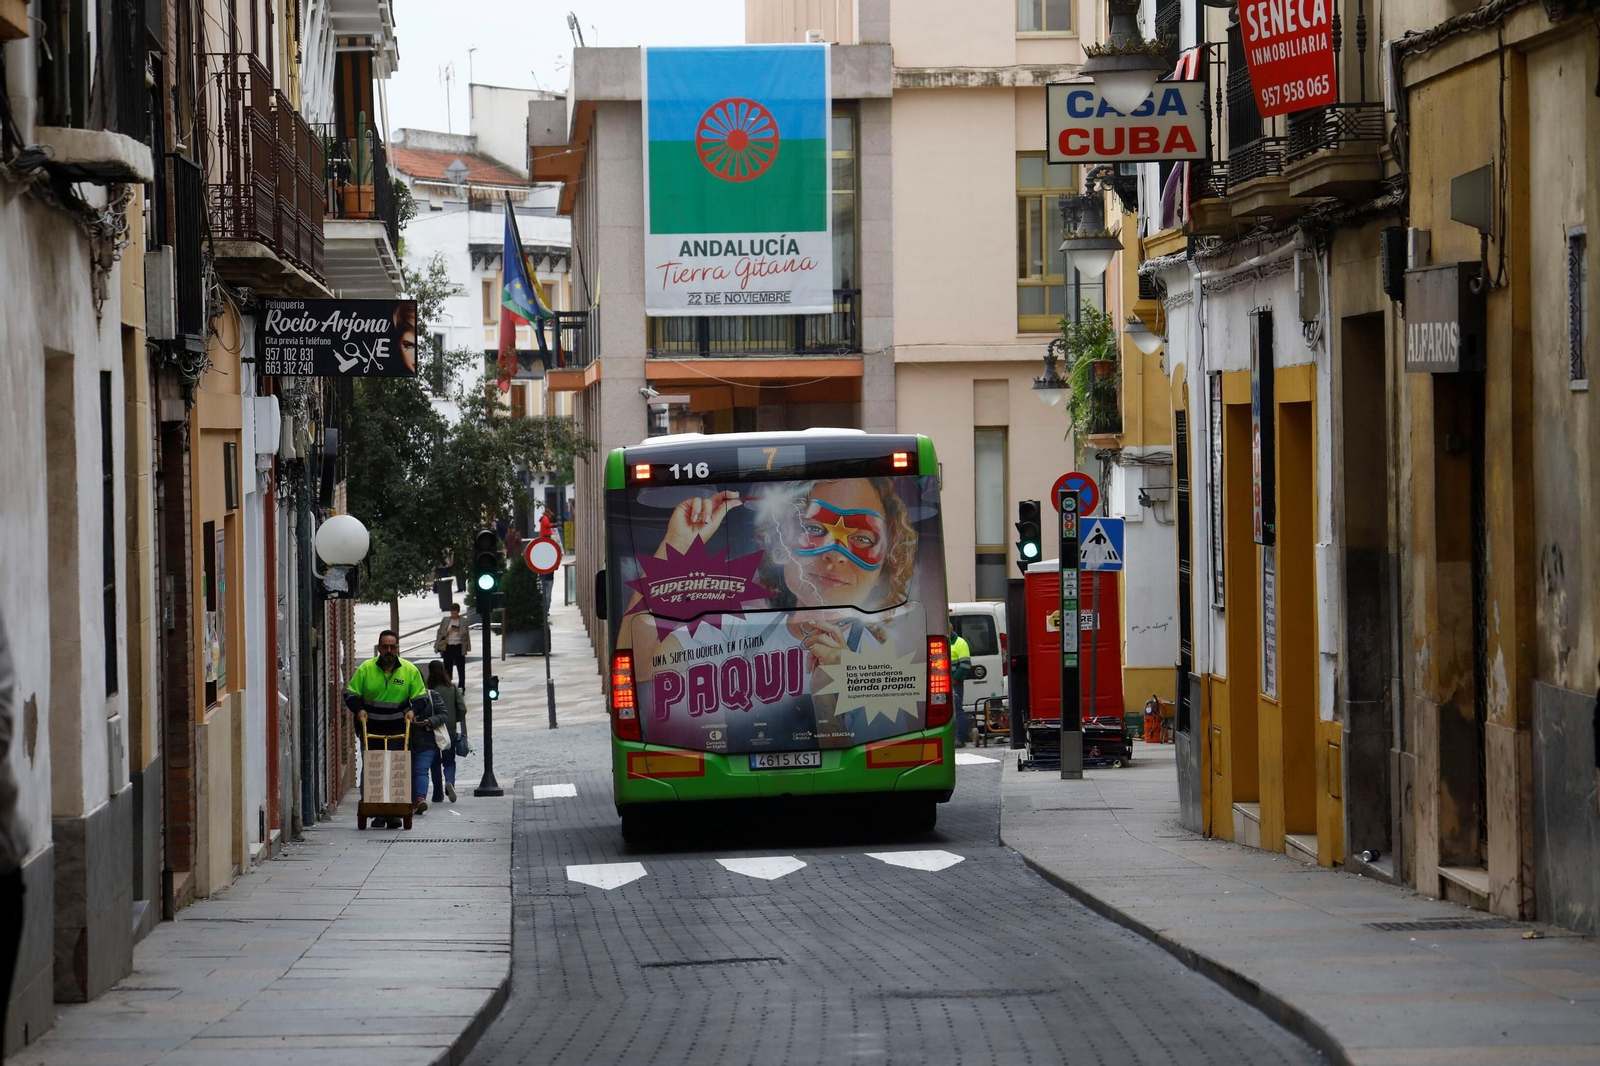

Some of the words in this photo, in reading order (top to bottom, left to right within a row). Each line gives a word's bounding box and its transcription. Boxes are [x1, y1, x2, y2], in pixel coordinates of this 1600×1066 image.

[1246, 0, 1327, 42] SENECA
[1251, 32, 1328, 67] INMOBILIARIA
[1261, 85, 1281, 108] 957
[1283, 80, 1305, 103] 958
[1306, 73, 1330, 98] 065
[1058, 125, 1198, 156] CUBA
[678, 234, 800, 257] ANDALUCÍA
[656, 260, 731, 290] Tierra
[734, 256, 819, 290] Gitana
[688, 293, 701, 304] 22
[705, 293, 721, 304] DE
[724, 292, 791, 304] NOVIEMBRE
[320, 309, 391, 341] Arjona
[265, 336, 278, 346] Cita
[279, 337, 299, 346] previa
[305, 337, 332, 346] Teléfono
[1407, 321, 1459, 363] ALFAROS
[265, 347, 281, 361] 957
[283, 347, 297, 361] 102
[299, 347, 314, 361] 831
[265, 361, 281, 375] 663
[283, 361, 297, 375] 312
[298, 361, 314, 375] 240
[669, 462, 710, 480] 116
[762, 447, 778, 471] 7
[1253, 422, 1262, 537] CUBA
[670, 593, 683, 603] DE
[652, 654, 667, 668] UNA
[727, 640, 736, 653] EN
[738, 635, 765, 651] FÁTIMA
[652, 645, 804, 722] PAQUI
[847, 677, 882, 685] héroes
[847, 683, 880, 692] tienda
[881, 682, 916, 692] propia.
[758, 754, 790, 767] 4615
[794, 752, 818, 765] KST
